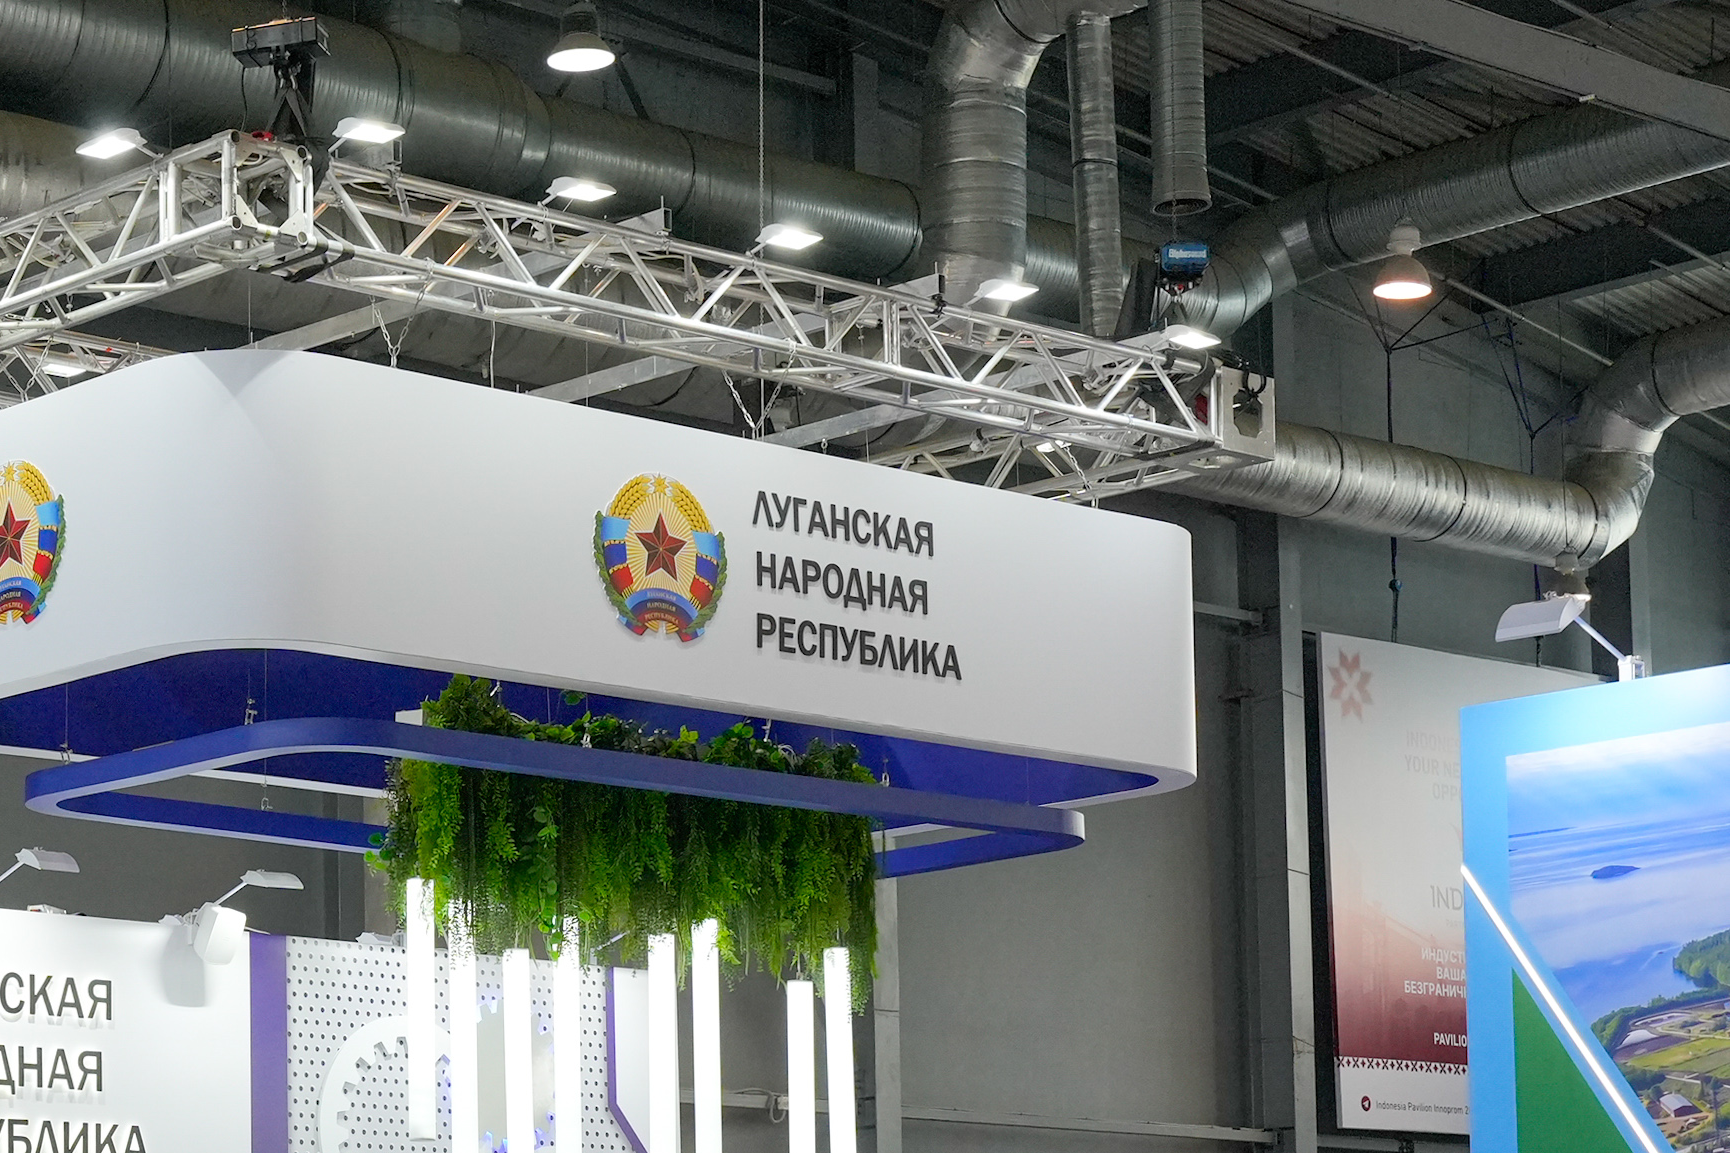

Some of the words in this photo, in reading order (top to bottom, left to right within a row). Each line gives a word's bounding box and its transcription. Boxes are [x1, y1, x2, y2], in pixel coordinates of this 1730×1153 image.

[752, 490, 934, 557] ЛУГАНСКАЯ
[756, 551, 928, 615] НАРОДНАЯ
[756, 612, 962, 681] РЕСПУБЛИКА
[1432, 783, 1461, 801] OPP
[1436, 966, 1467, 982] ВАША
[1376, 1100, 1407, 1111] Indonesia
[1407, 1101, 1433, 1112] Pavilion
[1433, 1104, 1464, 1115] Innoprom
